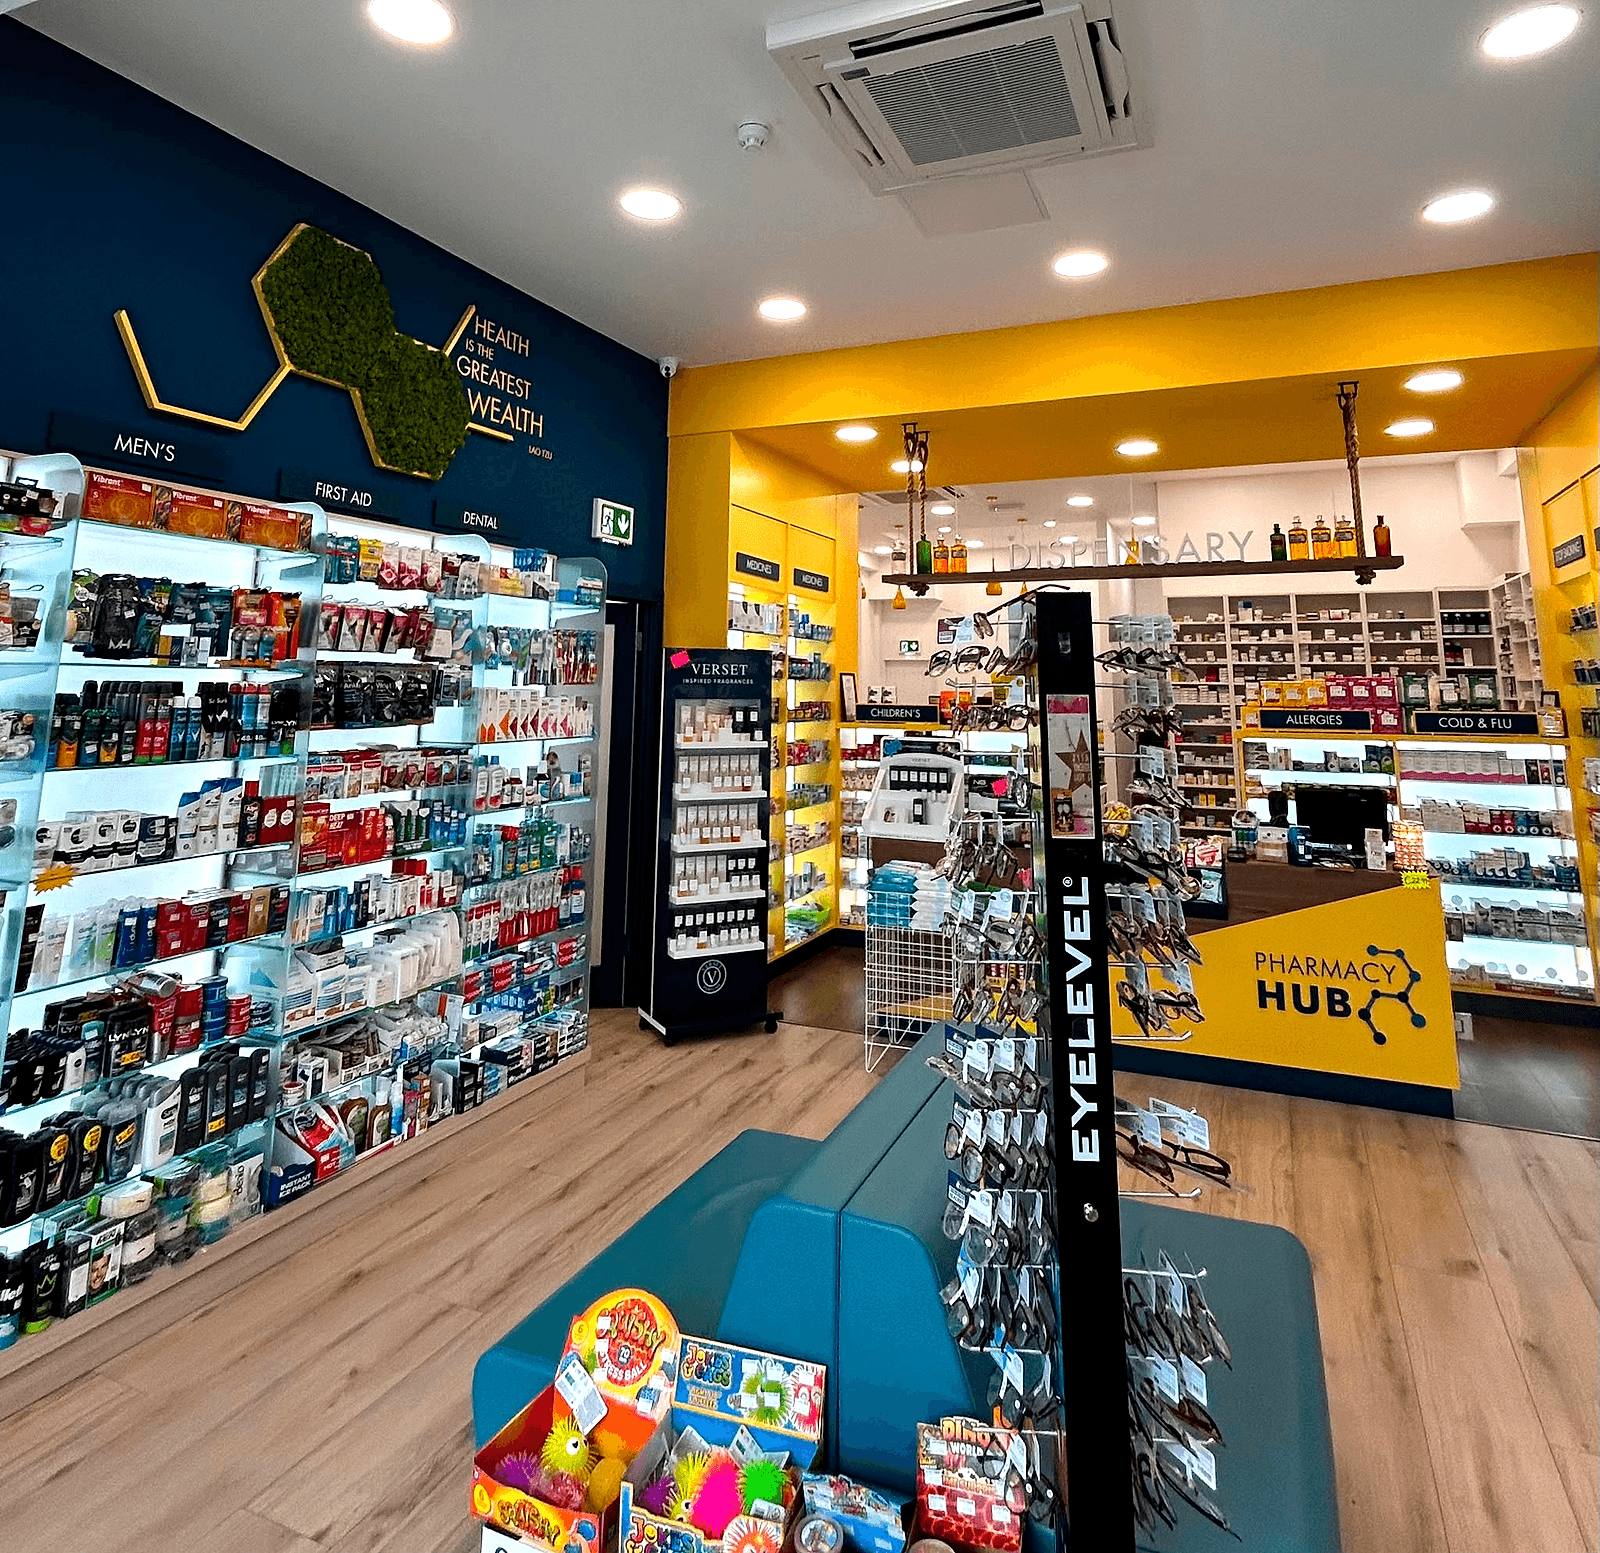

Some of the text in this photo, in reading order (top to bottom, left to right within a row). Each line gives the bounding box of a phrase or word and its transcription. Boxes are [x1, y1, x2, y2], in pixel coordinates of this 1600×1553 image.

[474, 315, 530, 357] HEALTH
[465, 338, 495, 361] IS THE
[456, 355, 532, 400] GREATEST
[467, 387, 544, 438] WEALTH
[114, 434, 175, 462] MEN'S
[92, 474, 123, 486] Vibrant
[172, 490, 198, 502] Vibrant
[315, 481, 373, 507] FIRST AID
[246, 504, 271, 516] Vibrant
[462, 511, 499, 530] DENTAL
[1007, 530, 1254, 571] DISPENSARY
[691, 663, 749, 676] VERSET
[870, 708, 921, 719] CHILDREN'S
[1285, 714, 1343, 726] ALLERGIES
[1438, 717, 1513, 729] COLD & FLU
[328, 813, 346, 822] DEEP
[1255, 951, 1397, 984] PHARMACY
[1257, 979, 1352, 1018] HUB
[1063, 876, 1100, 1162] EYELEVEL
[279, 1180, 312, 1198] ICE PACK
[280, 1172, 312, 1191] INSTANT
[685, 1344, 730, 1371] JOKES
[624, 1360, 648, 1381] BALL
[695, 1363, 731, 1387] GAGS
[942, 1418, 991, 1449] DINO
[950, 1441, 984, 1457] WORLD
